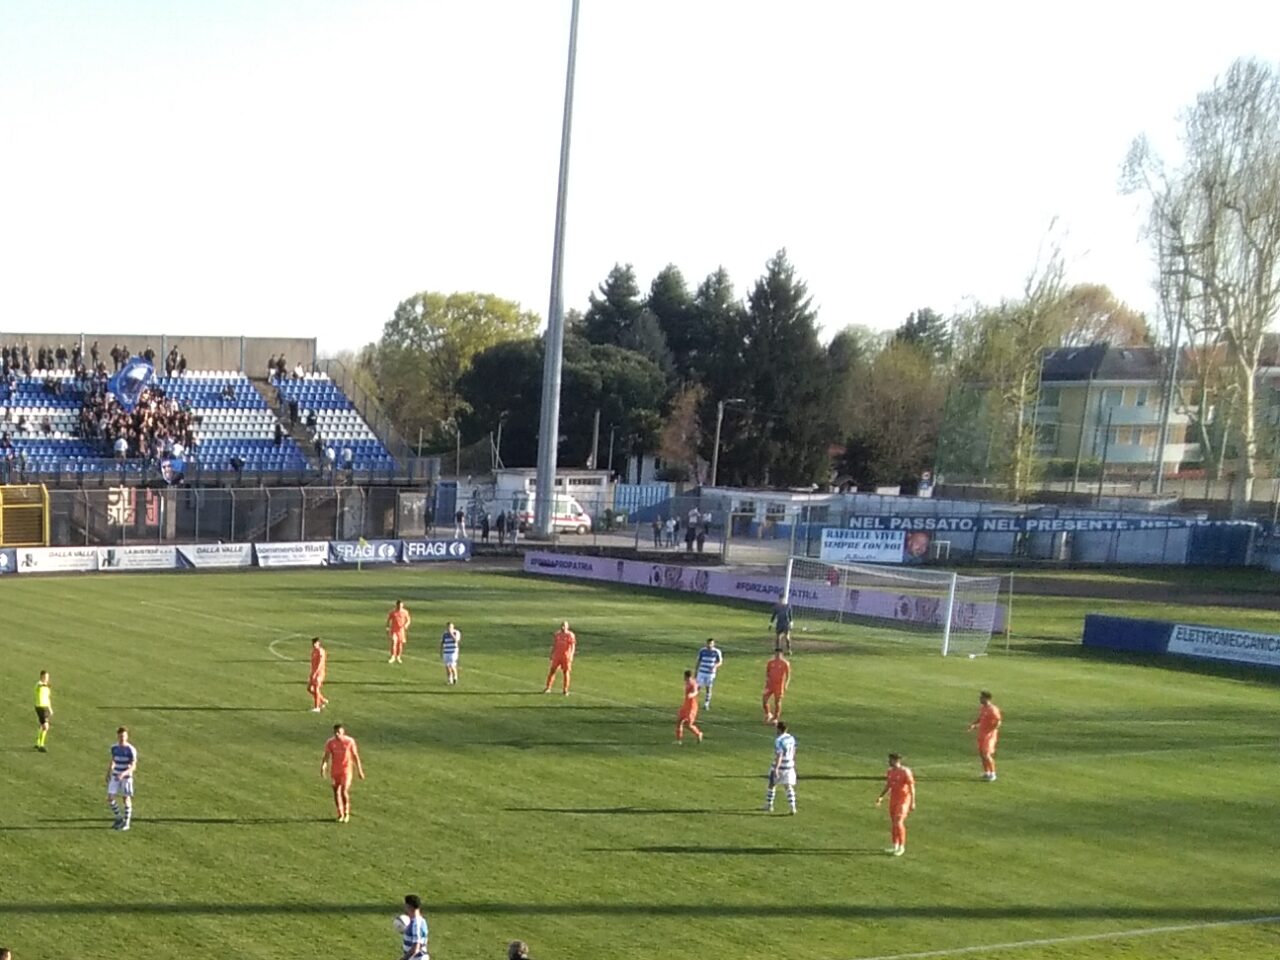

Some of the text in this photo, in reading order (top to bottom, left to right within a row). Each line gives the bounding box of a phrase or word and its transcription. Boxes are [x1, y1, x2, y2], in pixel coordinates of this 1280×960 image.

[849, 517, 883, 530] NEL
[889, 517, 977, 532] PASSATO,
[983, 519, 1020, 531] NEL
[1025, 518, 1135, 532] PRESENTE,
[826, 530, 871, 540] RAFFAELE
[875, 531, 897, 541] VIVE
[196, 546, 220, 554] DALLA
[337, 544, 375, 558] FRAGI
[408, 542, 447, 556] FRAGI
[823, 541, 902, 551] SEMPRE CON NOI
[735, 581, 819, 601] #FORZAPRPATRIA
